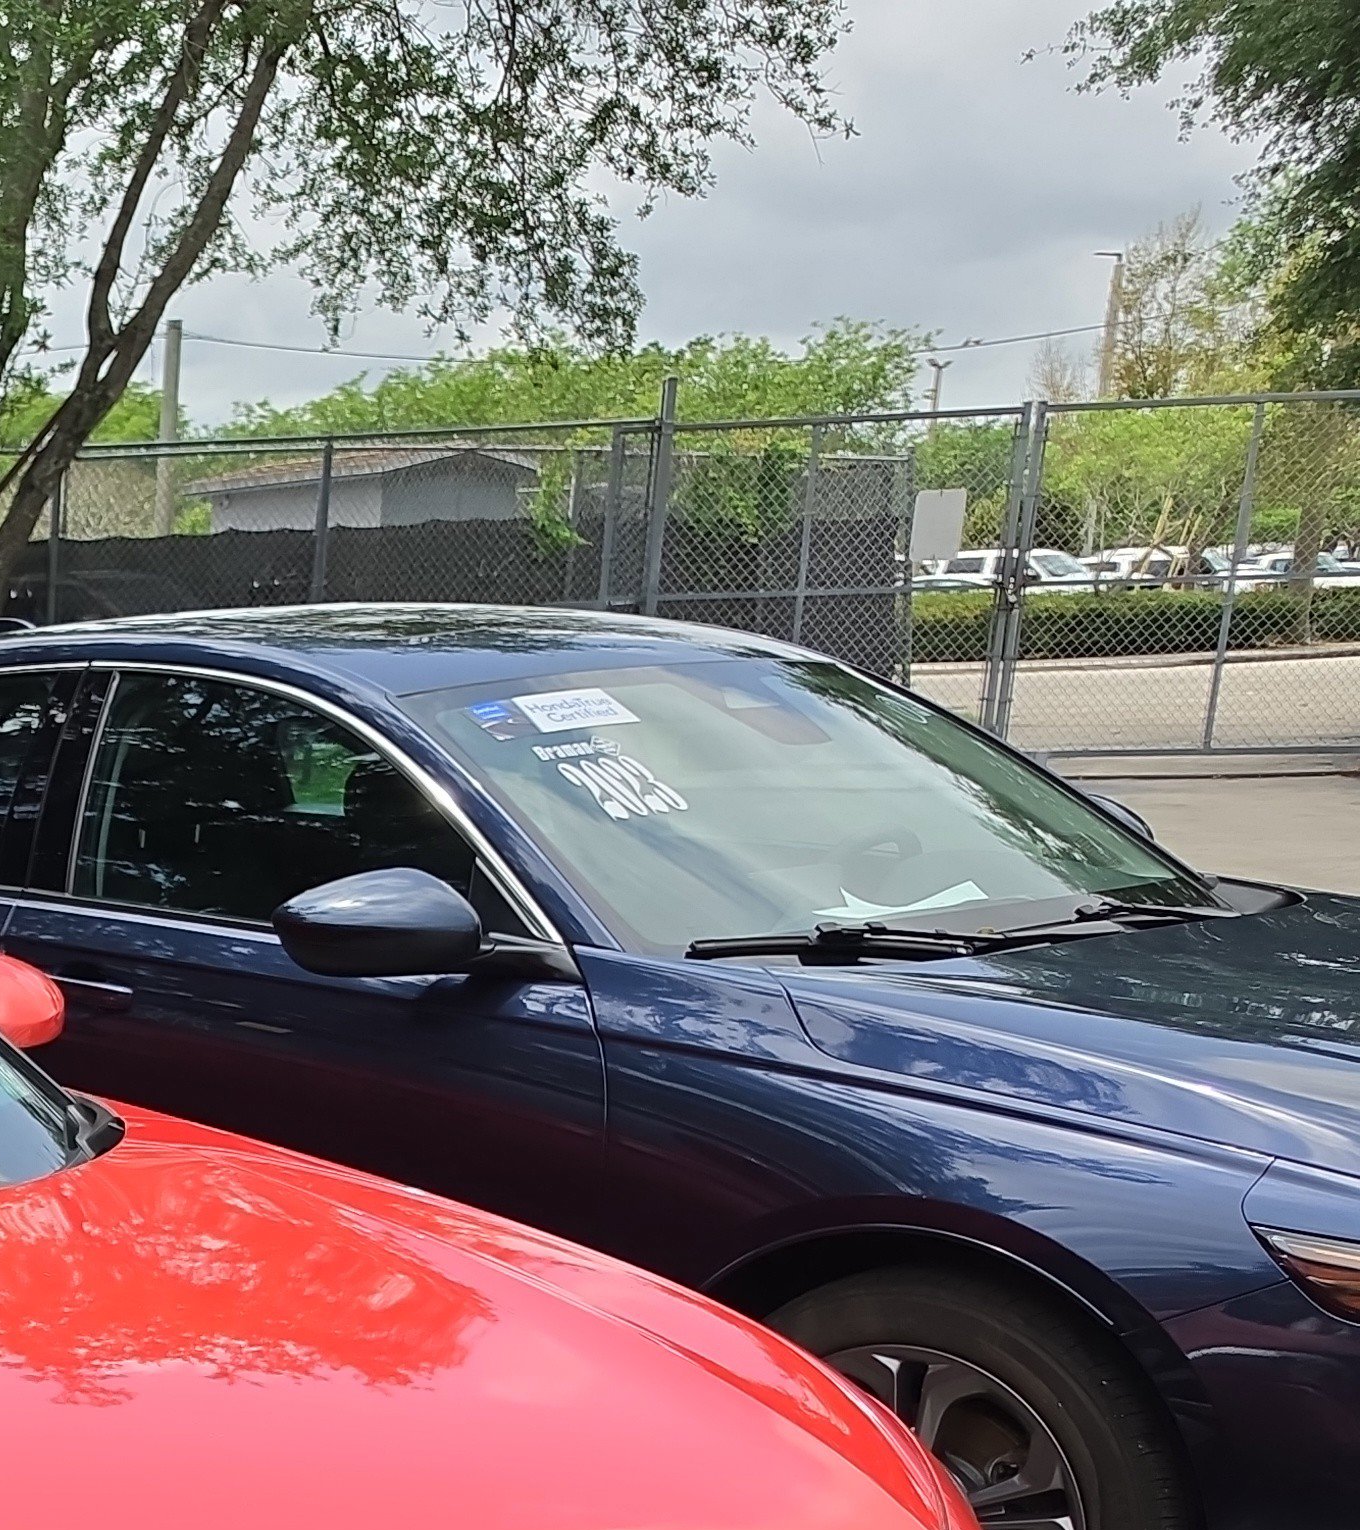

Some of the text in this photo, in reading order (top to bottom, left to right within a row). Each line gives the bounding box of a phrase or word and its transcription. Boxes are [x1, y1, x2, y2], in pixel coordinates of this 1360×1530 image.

[547, 707, 618, 723] Certified
[532, 741, 595, 761] Braman
[557, 755, 689, 822] 2023
